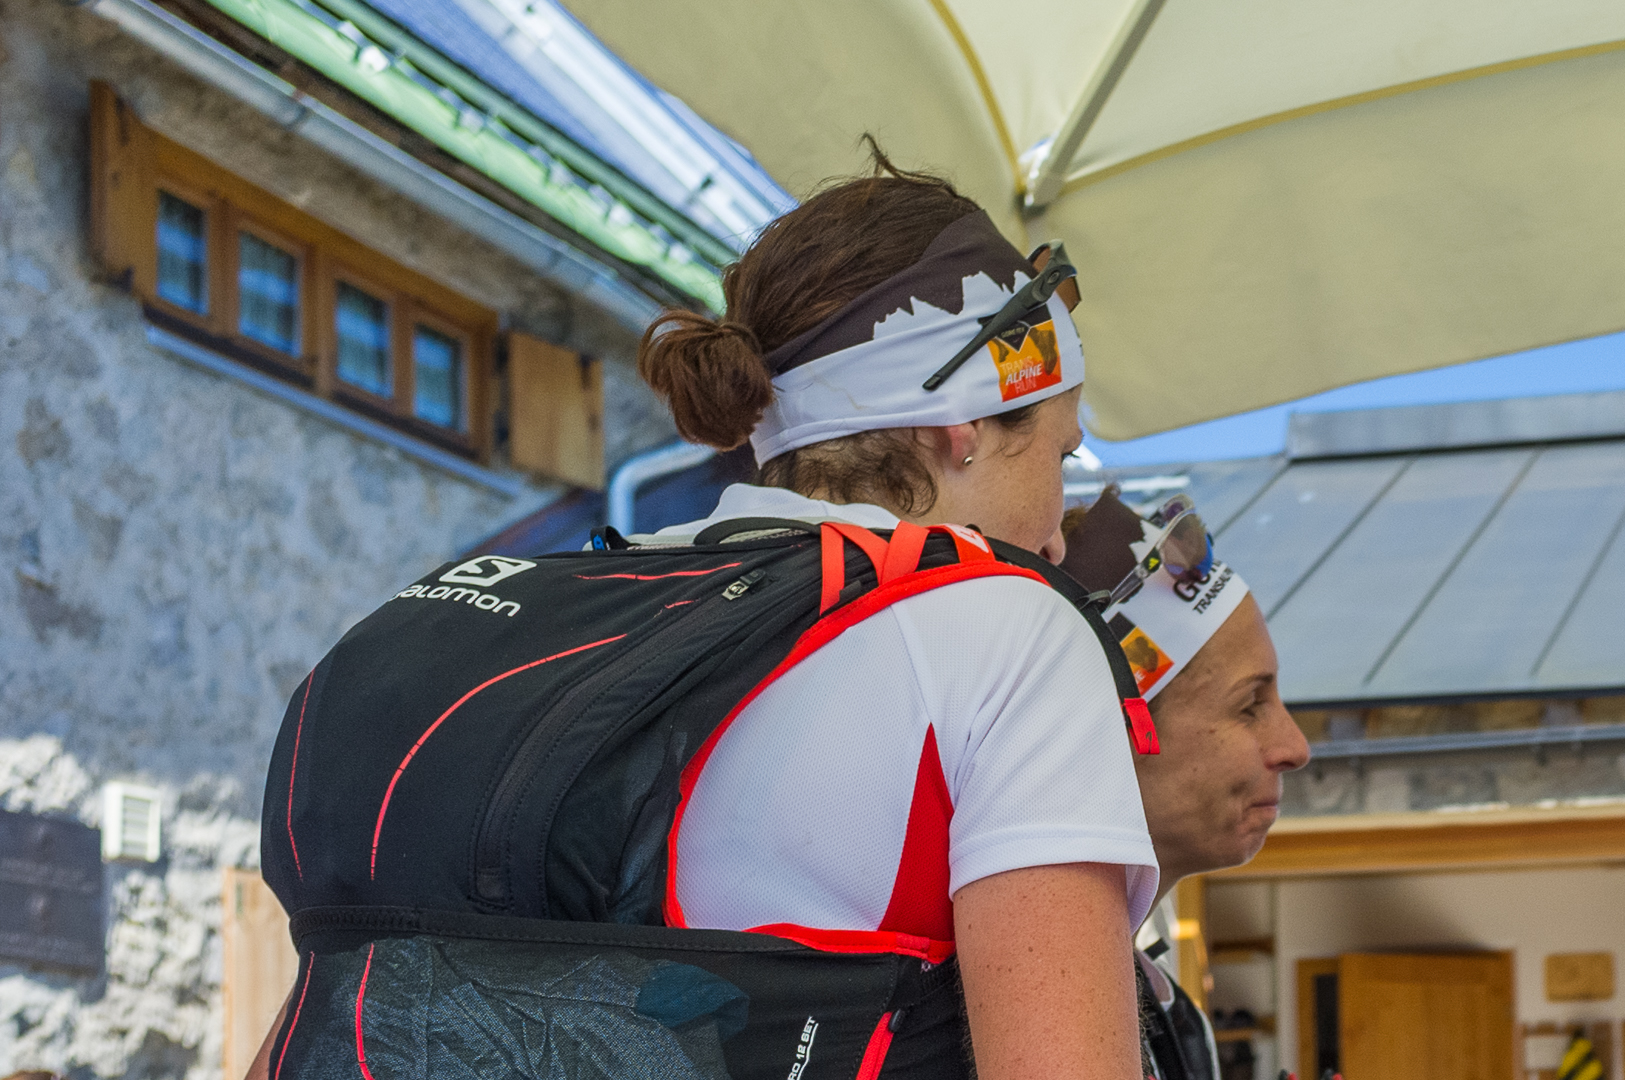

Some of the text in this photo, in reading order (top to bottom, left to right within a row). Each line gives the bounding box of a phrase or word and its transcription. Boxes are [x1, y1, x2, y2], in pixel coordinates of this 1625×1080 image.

[1005, 364, 1043, 385] ALPINE
[1014, 378, 1037, 394] RUN
[796, 1044, 806, 1060] 12
[801, 1016, 816, 1043] SET
